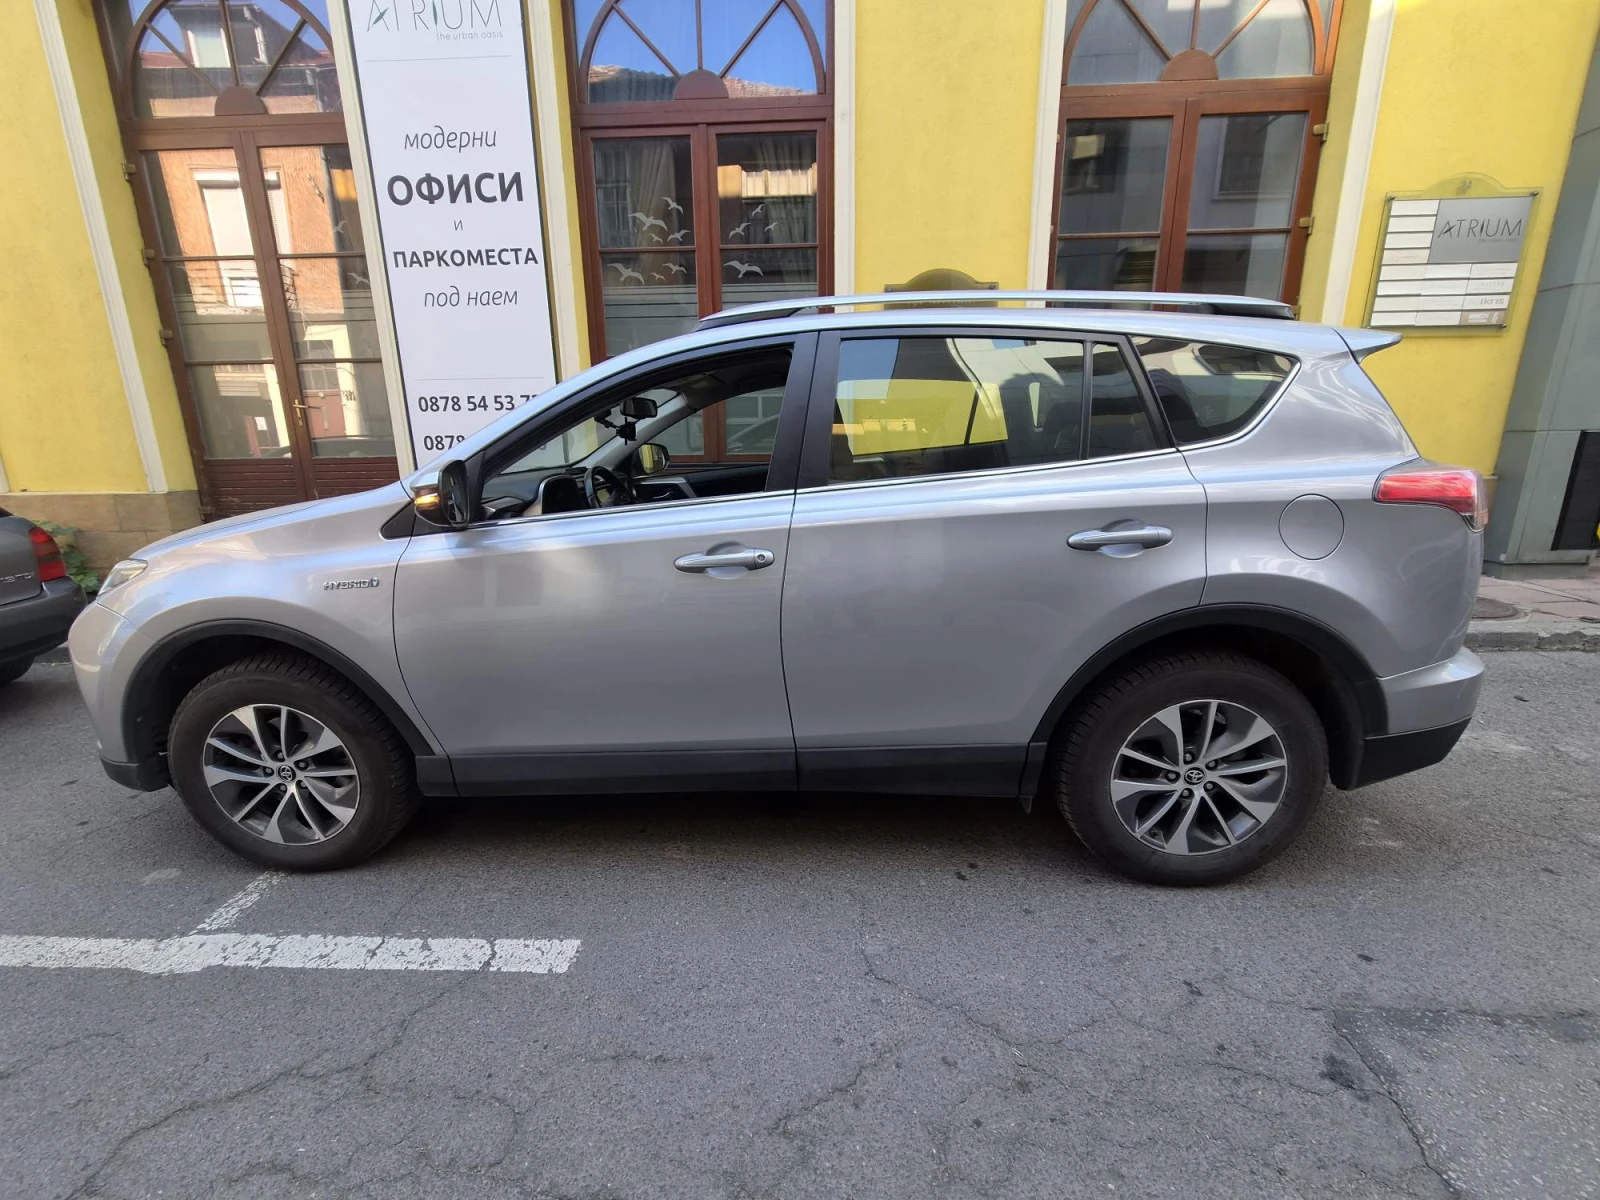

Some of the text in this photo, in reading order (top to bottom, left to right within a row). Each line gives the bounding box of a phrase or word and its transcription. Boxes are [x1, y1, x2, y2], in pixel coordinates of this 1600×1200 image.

[436, 30, 504, 41] the urban oasis
[404, 125, 497, 153] модерни
[387, 171, 524, 206] ОФИСИ
[1437, 218, 1523, 239] ATRIUM
[393, 247, 539, 268] ПАРКОМЕСТА
[424, 285, 518, 307] под наем
[418, 394, 538, 412] 0878 54 53 7
